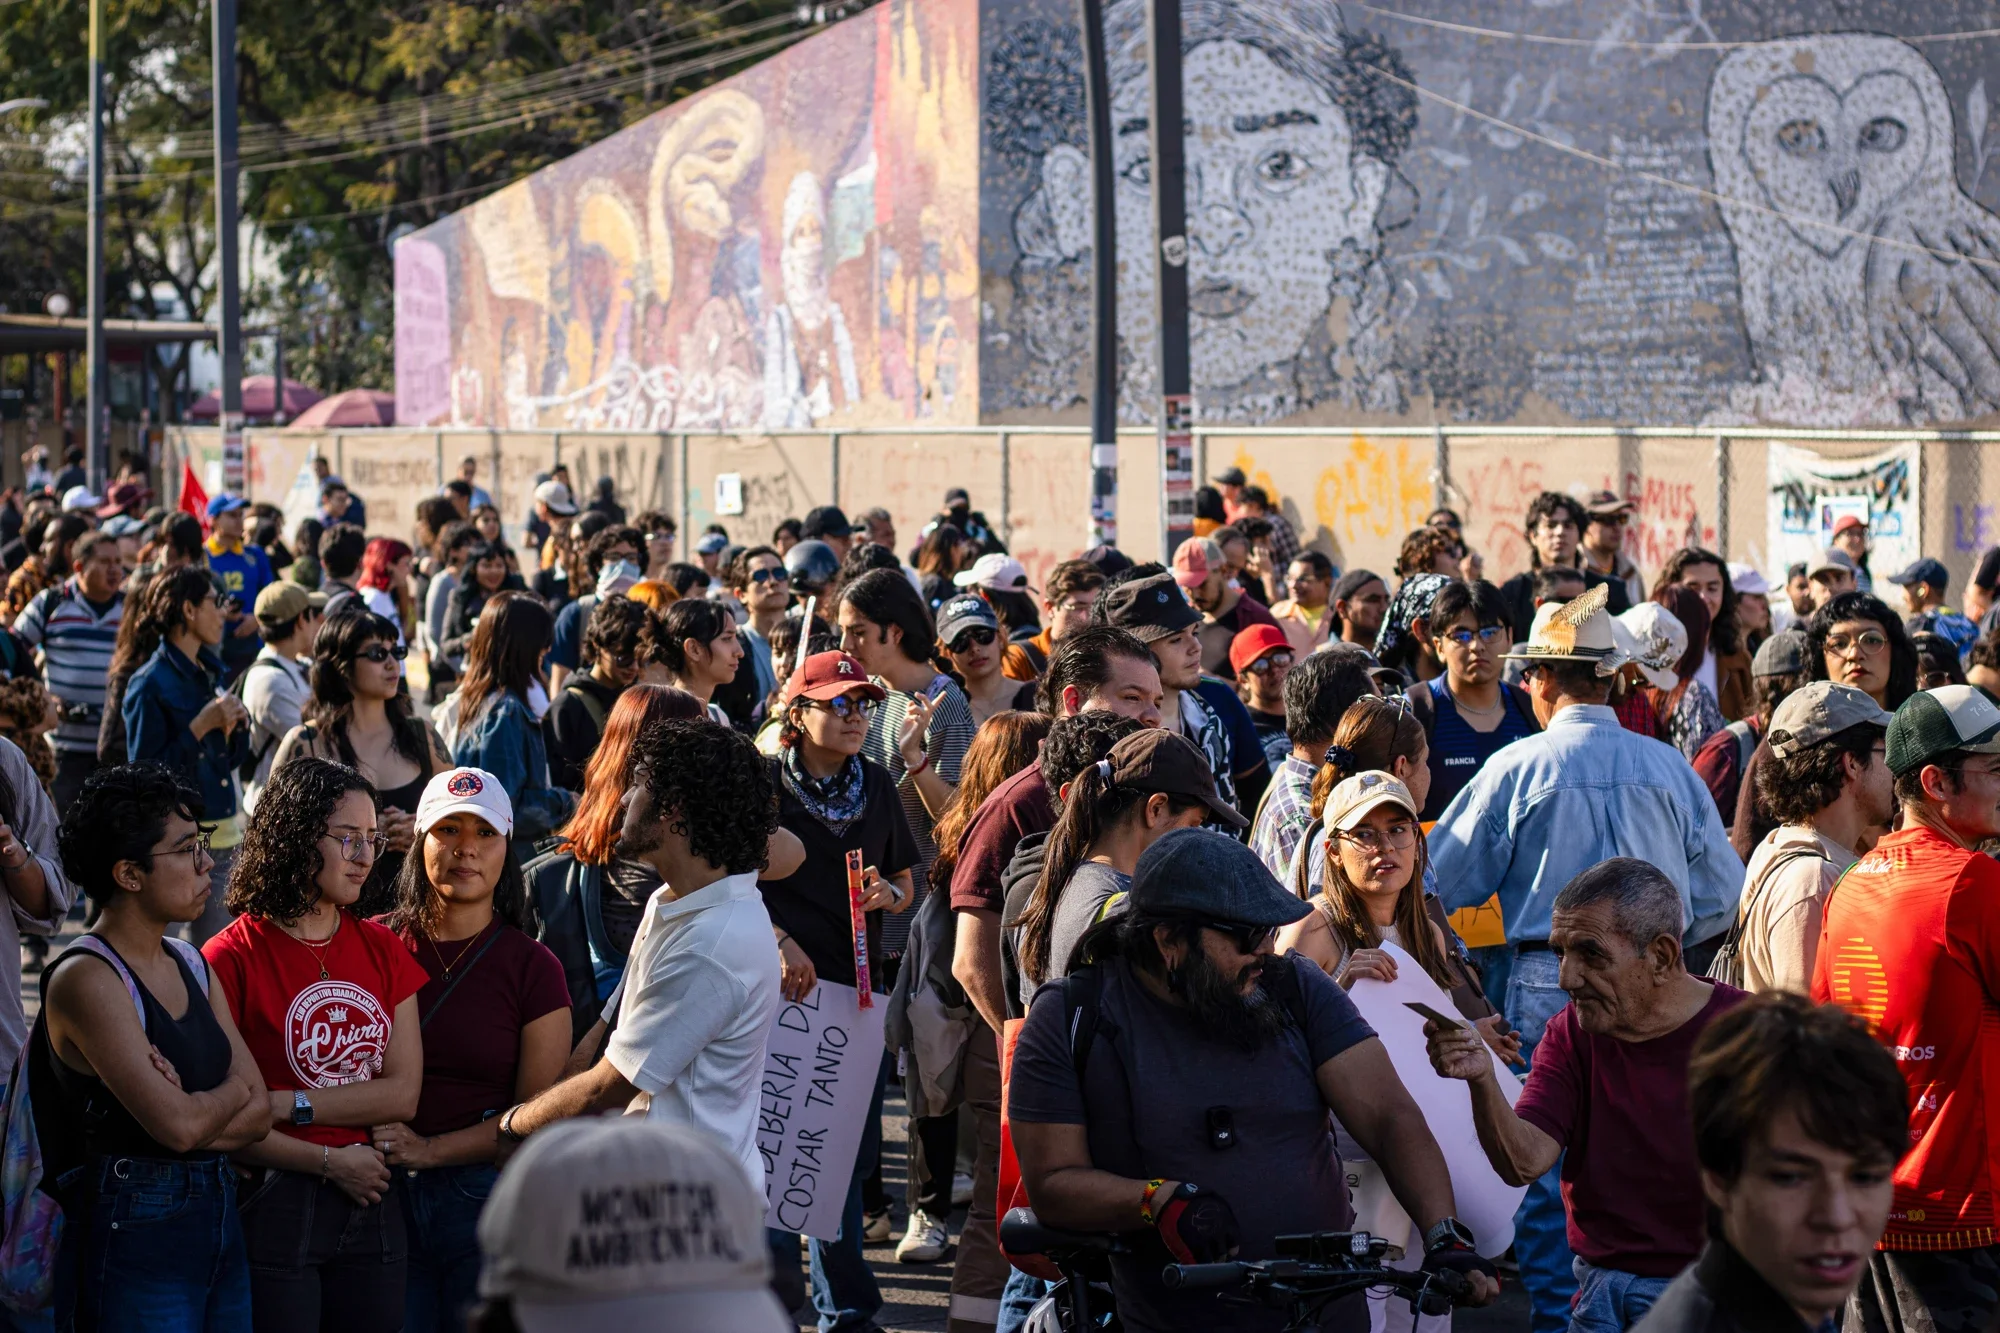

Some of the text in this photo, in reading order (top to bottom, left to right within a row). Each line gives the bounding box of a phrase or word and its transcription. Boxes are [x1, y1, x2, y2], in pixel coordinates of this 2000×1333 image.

[947, 600, 979, 616] Jeep
[1444, 756, 1476, 766] FRANCIA
[301, 988, 332, 1009] DEPORTIVO
[332, 988, 376, 1013] GUADALAJARA
[297, 1022, 385, 1062] Chivas
[1884, 1045, 1935, 1061] GROS
[759, 1052, 802, 1174] DEBERIA
[777, 1128, 829, 1231] COSTAR
[1907, 1208, 1926, 1222] 100
